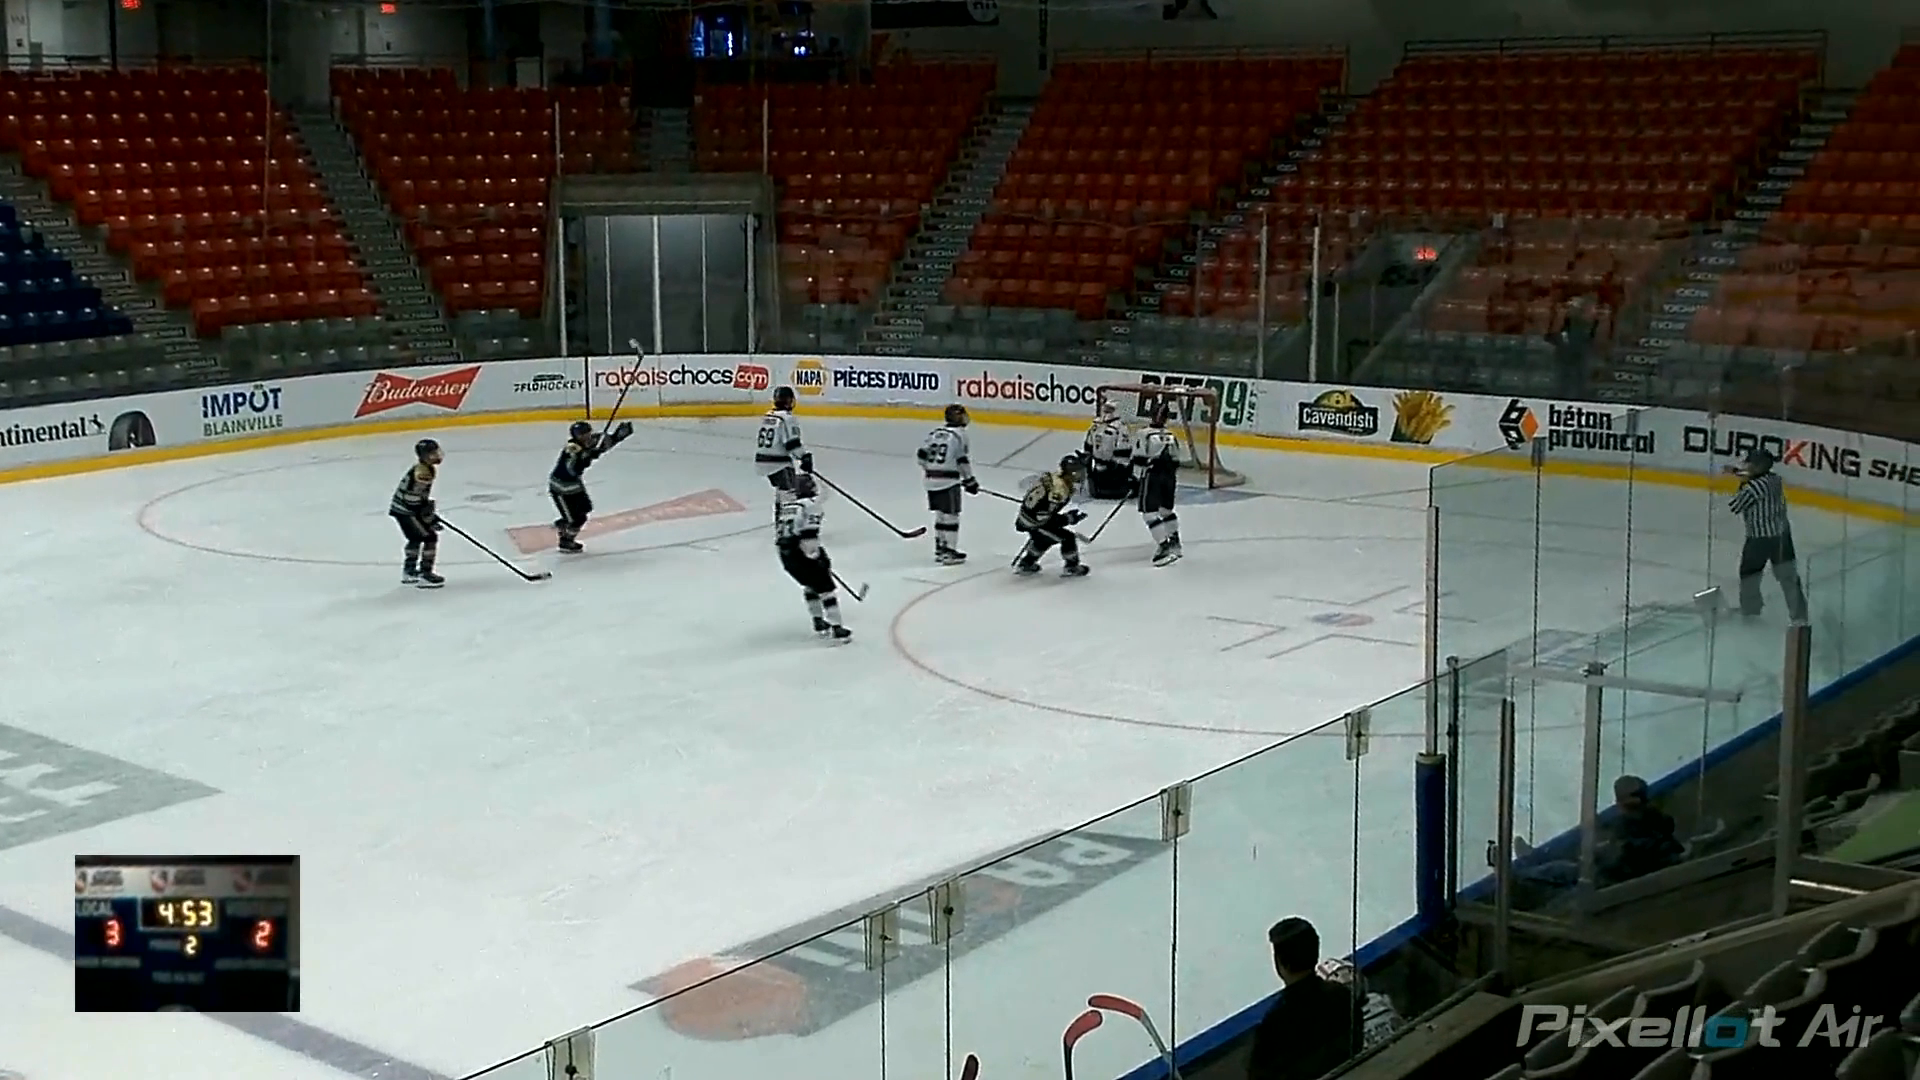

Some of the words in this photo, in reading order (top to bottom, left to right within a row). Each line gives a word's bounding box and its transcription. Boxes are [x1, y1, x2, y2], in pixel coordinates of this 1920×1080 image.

[796, 371, 823, 386] NAPA
[834, 366, 886, 389] PIÈCES
[889, 372, 939, 390] D'AUTO
[957, 371, 1096, 404] rabaischoc
[366, 378, 471, 404] Budweiser
[204, 414, 283, 436] BLAINVILLE
[1303, 407, 1374, 429] Cavendish
[1549, 404, 1612, 430] béton
[758, 427, 775, 448] 69
[1549, 429, 1655, 454] provincal
[158, 900, 213, 927] 4:53
[106, 920, 121, 946] 3
[184, 936, 197, 955] 2
[255, 921, 272, 947] 2
